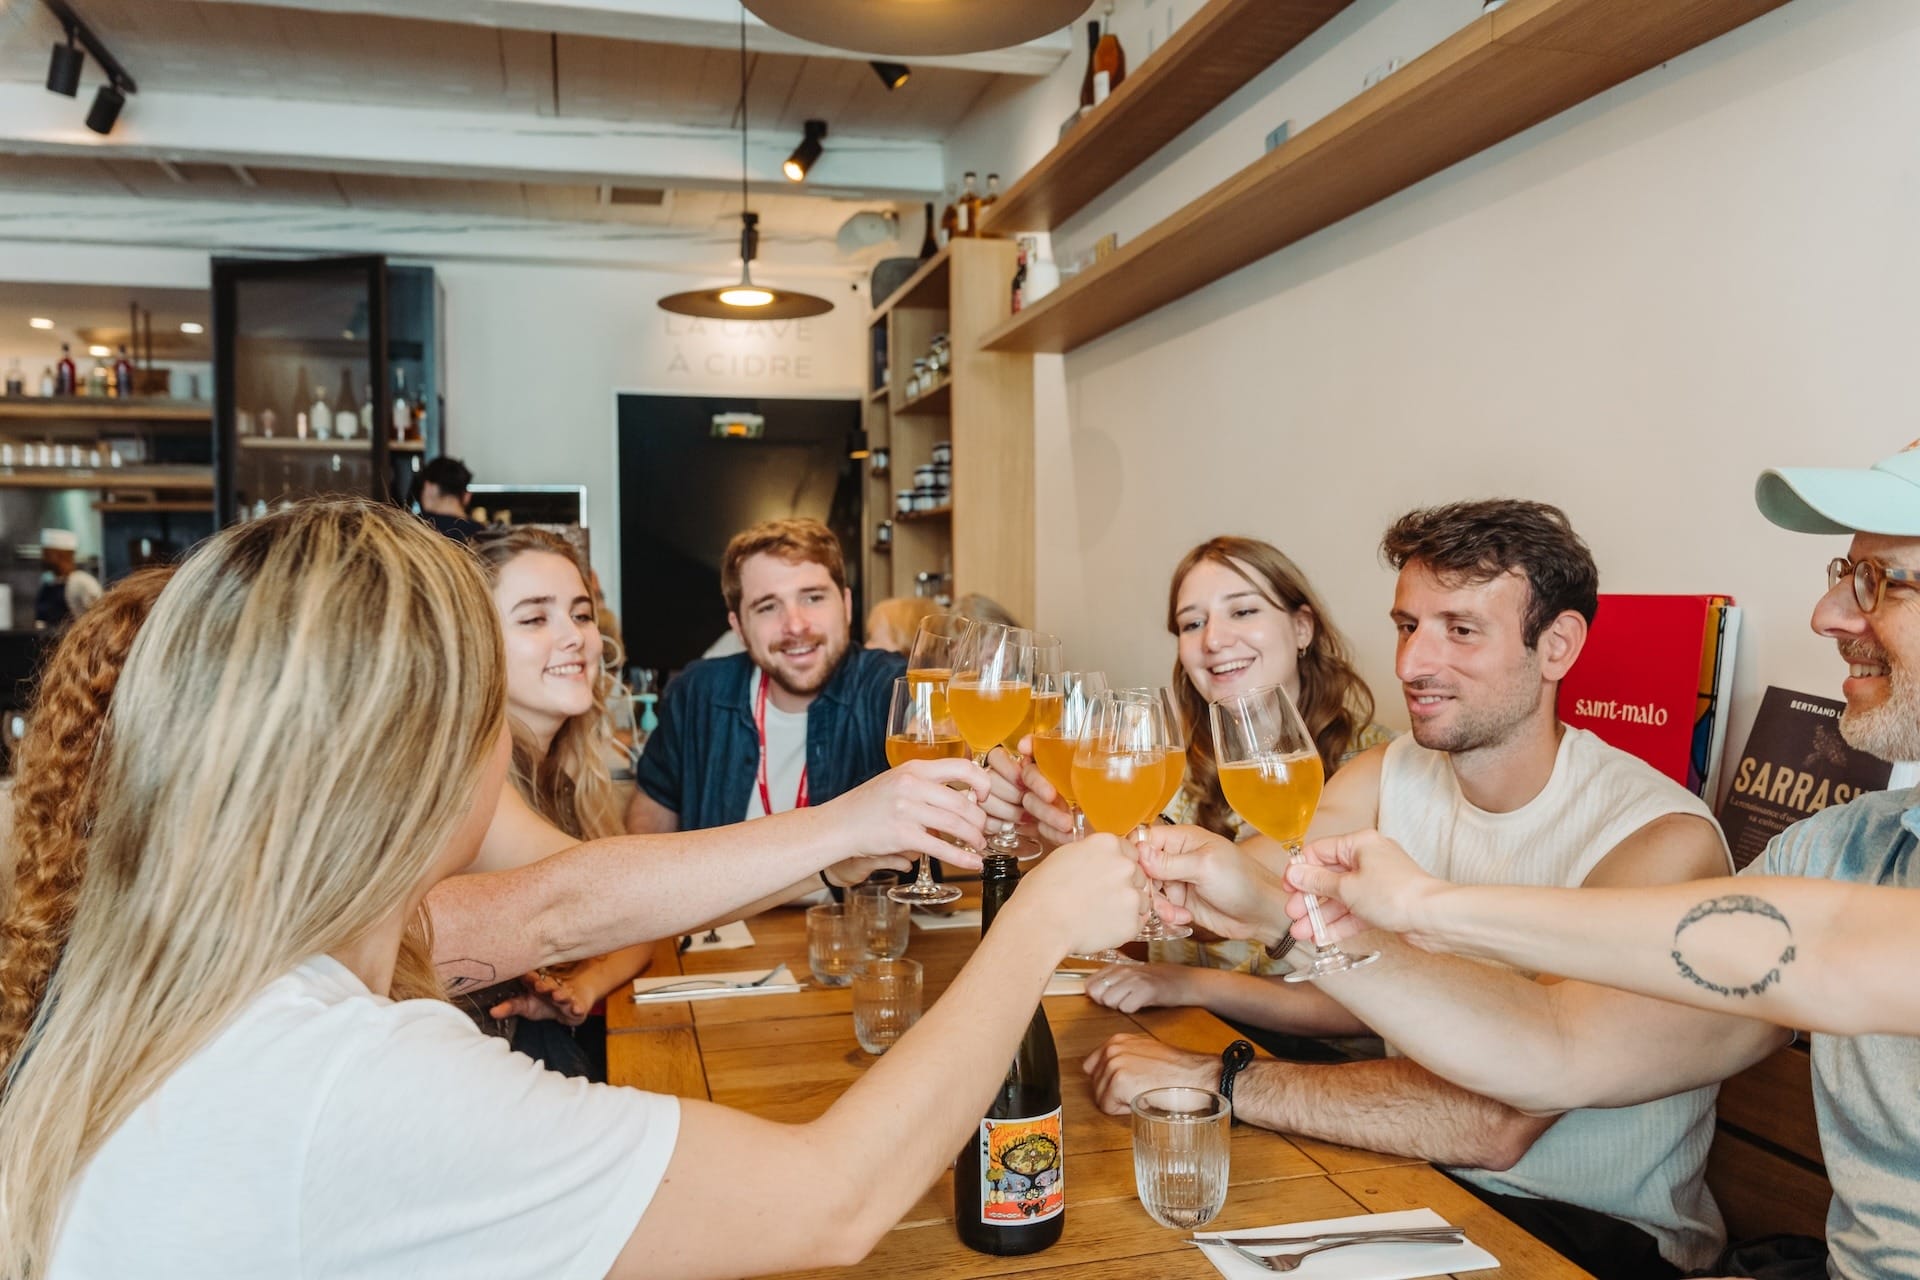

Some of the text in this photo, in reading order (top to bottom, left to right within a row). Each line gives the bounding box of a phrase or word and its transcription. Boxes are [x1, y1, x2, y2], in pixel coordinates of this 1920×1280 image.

[664, 316, 812, 342] LA CAVE
[667, 344, 812, 378] À CIDRE
[1790, 699, 1836, 718] BERTRAND
[1734, 756, 1866, 813] SARRAS
